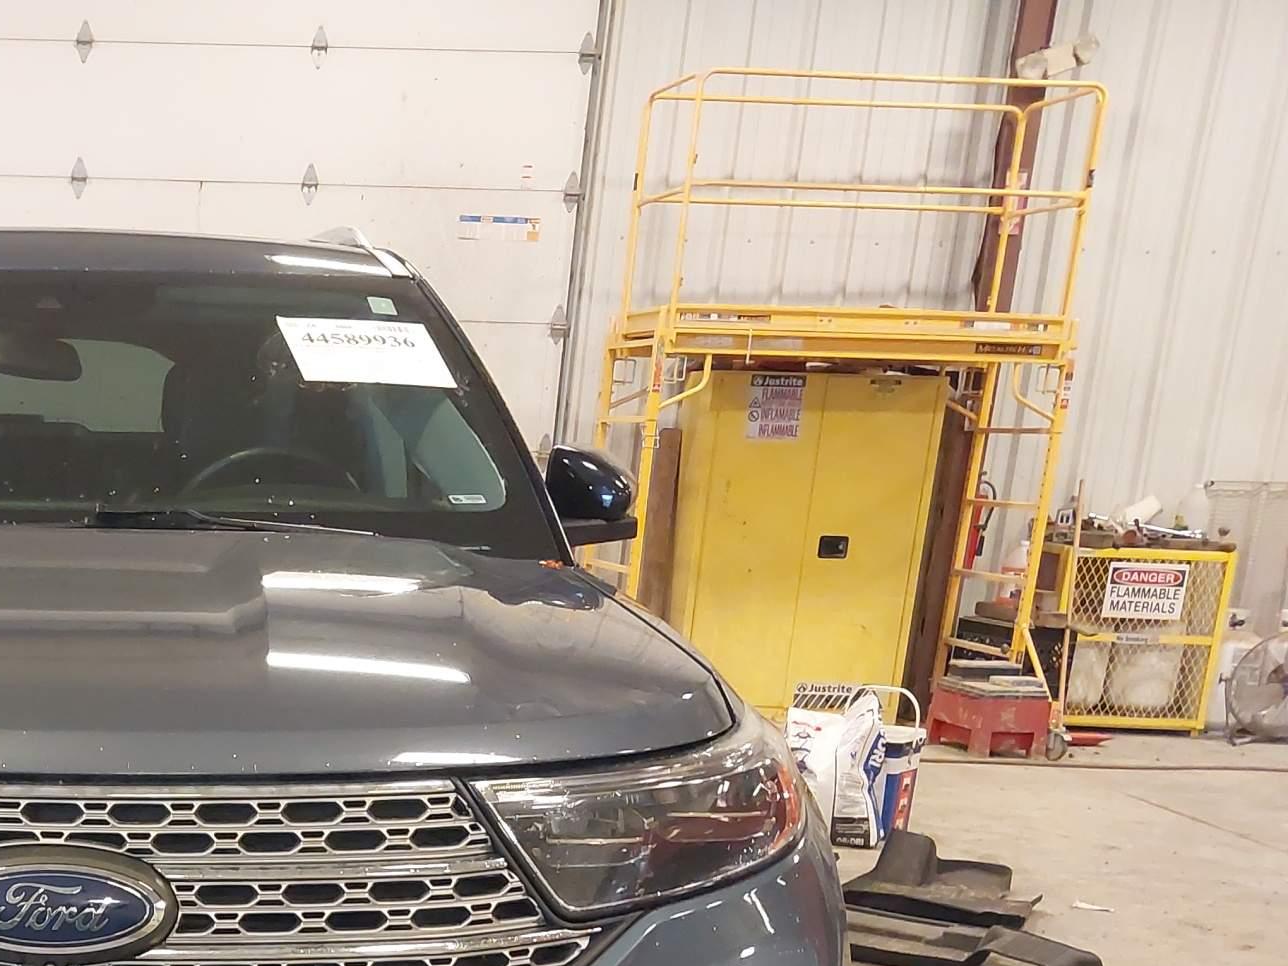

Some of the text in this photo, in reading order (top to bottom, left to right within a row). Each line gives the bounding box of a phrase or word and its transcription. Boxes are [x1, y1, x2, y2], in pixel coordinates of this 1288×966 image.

[302, 332, 416, 348] 44589936
[764, 376, 804, 387] Justrite
[761, 388, 803, 401] FLAMMABLE
[1121, 571, 1176, 583] DANGER
[1109, 586, 1181, 600] FLAMMABLE
[1108, 600, 1177, 614] MATERIALS
[808, 683, 853, 694] Justrite
